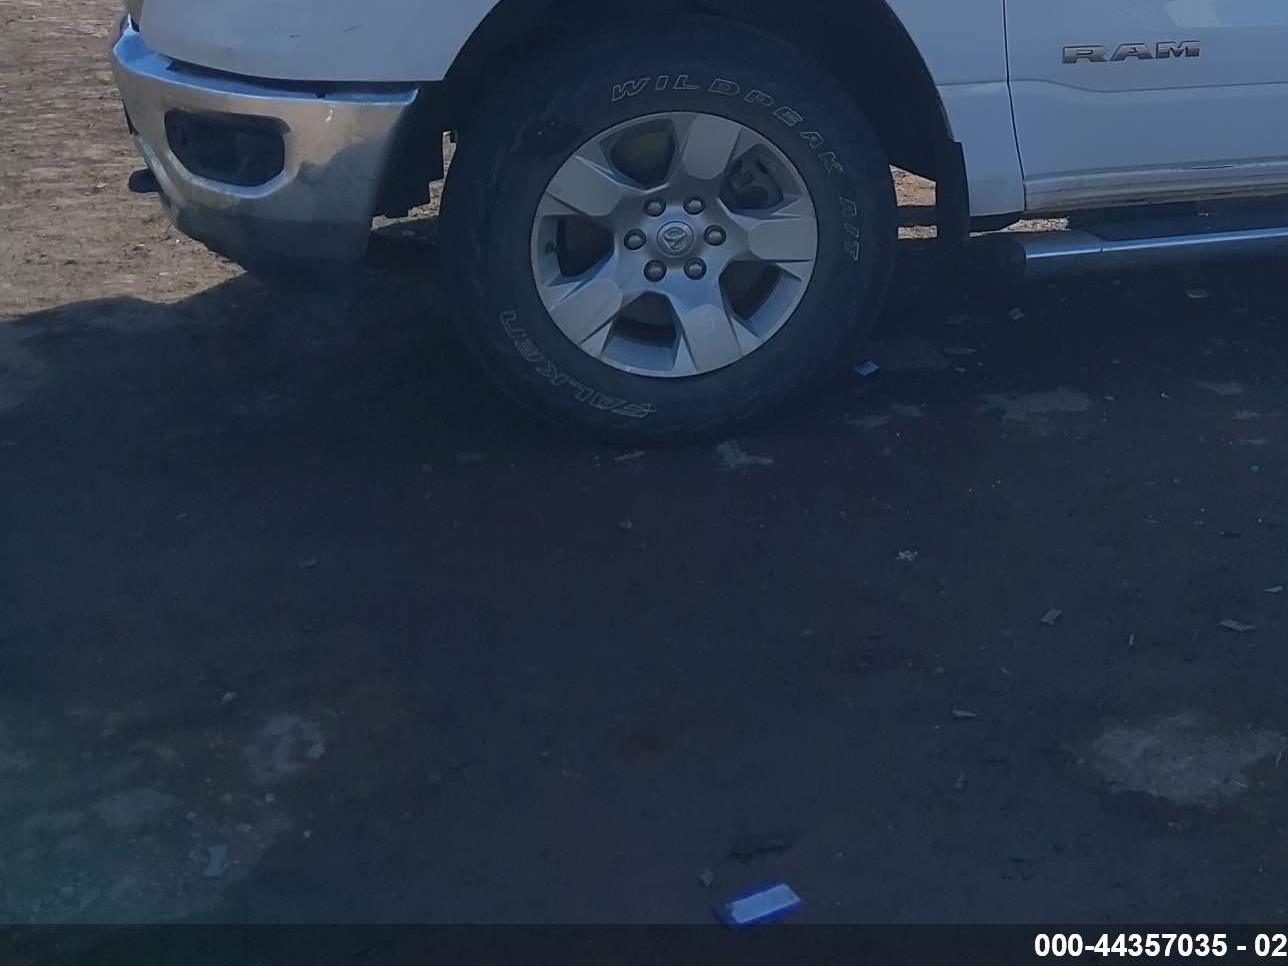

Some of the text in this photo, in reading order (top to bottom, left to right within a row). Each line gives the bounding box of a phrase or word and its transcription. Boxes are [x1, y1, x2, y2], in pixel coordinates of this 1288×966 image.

[1062, 40, 1201, 64] RAM
[611, 74, 844, 174] WILDPEAK
[500, 310, 657, 418] FALKEN
